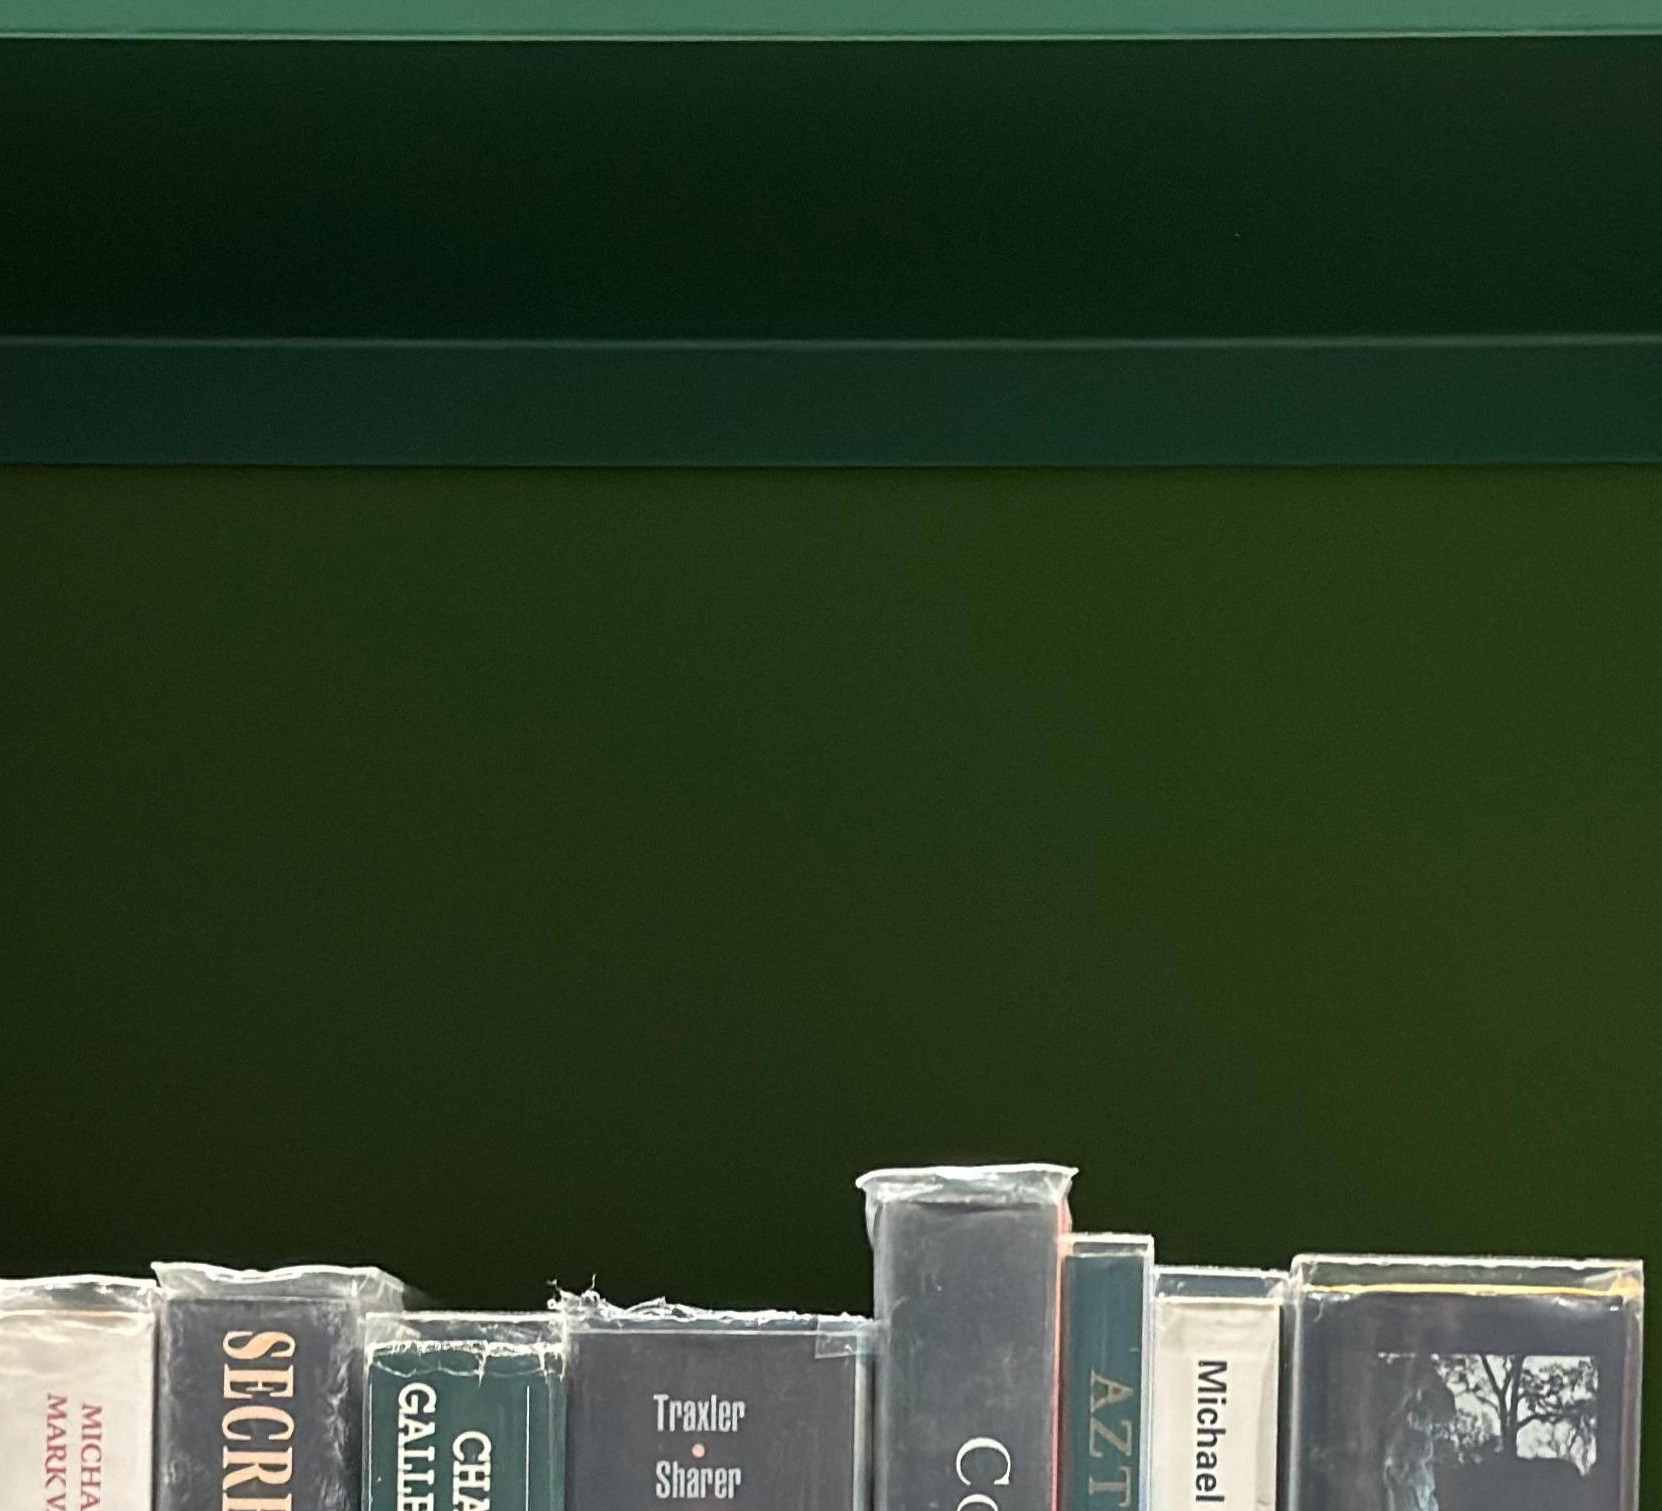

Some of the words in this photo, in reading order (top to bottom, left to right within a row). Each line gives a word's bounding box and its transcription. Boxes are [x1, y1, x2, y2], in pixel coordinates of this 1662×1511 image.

[44, 1394, 68, 1489] MARK
[653, 1394, 745, 1433] Traxler
[1196, 1359, 1226, 1511] Michael
[655, 1460, 741, 1501] Sharer
